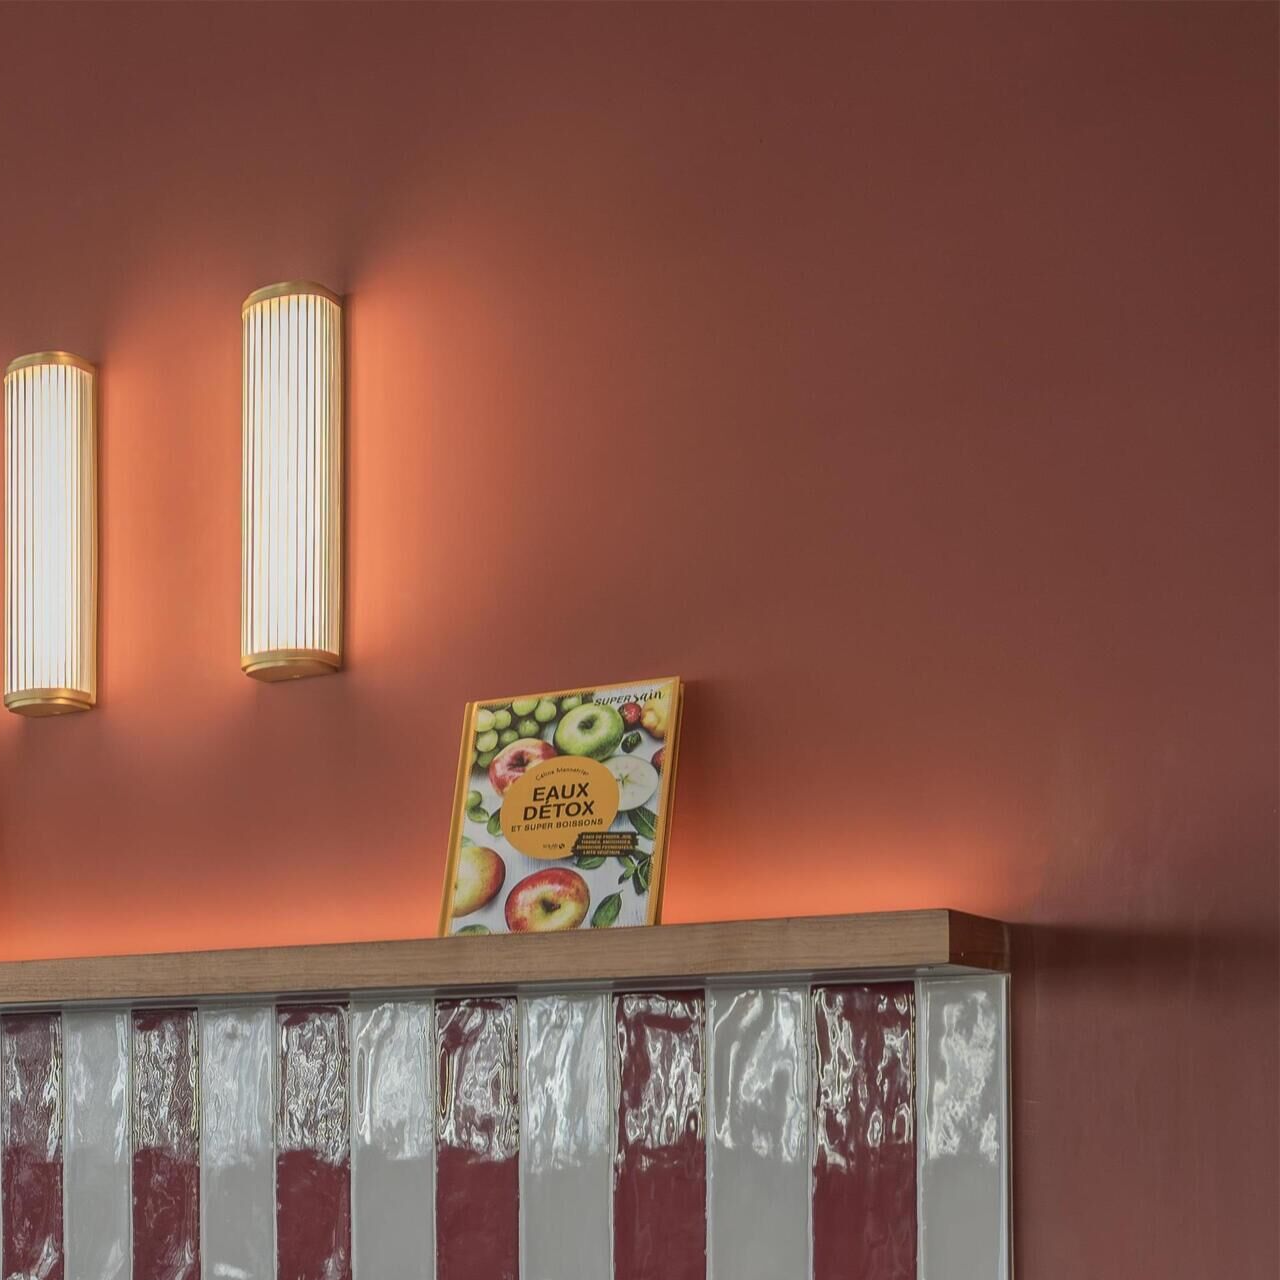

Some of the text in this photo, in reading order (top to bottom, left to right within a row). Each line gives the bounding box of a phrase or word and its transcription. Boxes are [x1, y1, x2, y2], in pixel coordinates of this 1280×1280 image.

[594, 694, 631, 706] SUPER
[532, 782, 590, 802] EAUX
[523, 800, 595, 821] DÉTOX
[511, 818, 603, 833] ET SUPER BOISSONS
